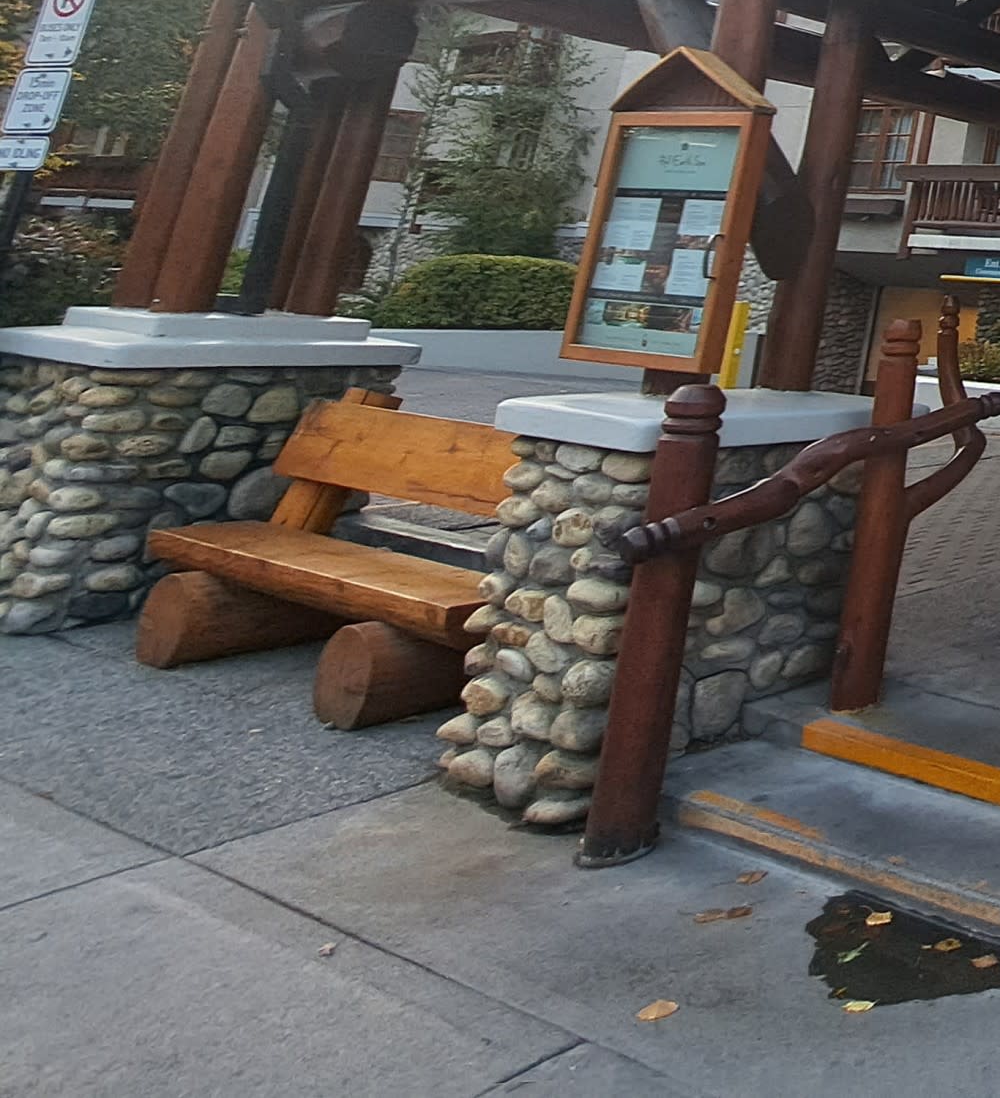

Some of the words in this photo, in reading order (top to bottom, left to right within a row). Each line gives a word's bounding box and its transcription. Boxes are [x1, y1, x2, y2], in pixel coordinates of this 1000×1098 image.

[17, 91, 60, 100] DROP-OFF
[22, 103, 46, 112] ZONE
[12, 147, 42, 159] IDLING
